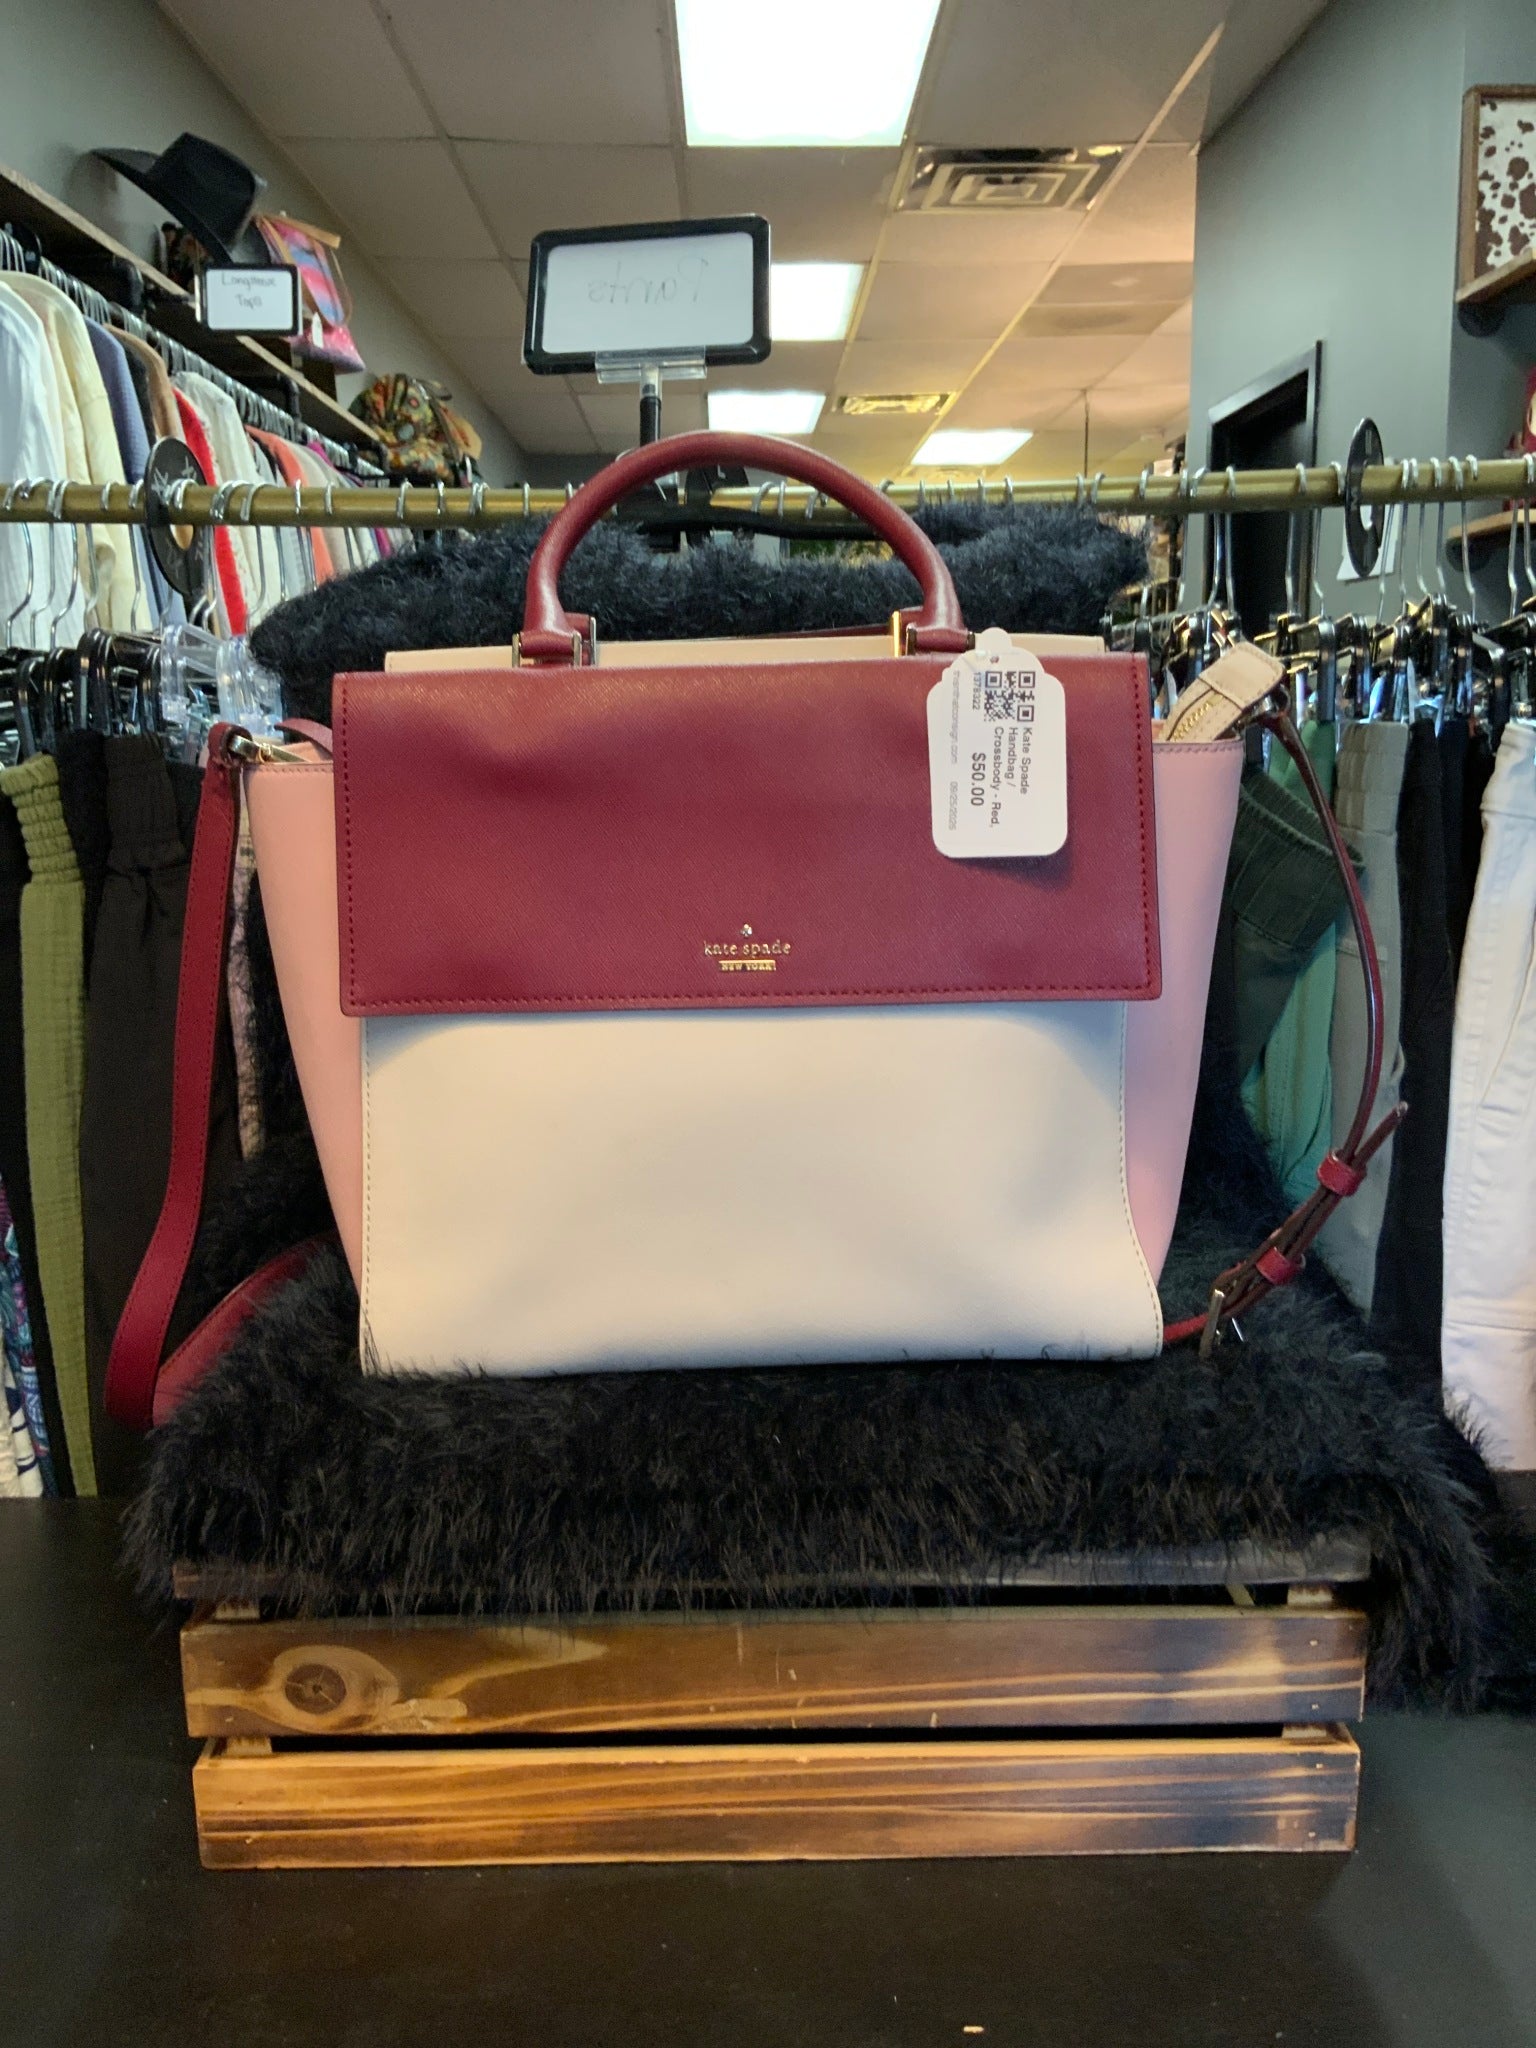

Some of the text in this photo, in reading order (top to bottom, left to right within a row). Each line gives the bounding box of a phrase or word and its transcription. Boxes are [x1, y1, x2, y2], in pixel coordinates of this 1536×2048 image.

[972, 671, 982, 711] 1378322
[970, 752, 987, 807] $50.00
[990, 727, 1004, 791] Crossbody
[1004, 727, 1019, 780] Handbag
[1020, 727, 1033, 795] Kate Spade
[989, 802, 1002, 828] Red,
[703, 939, 791, 959] kate spade
